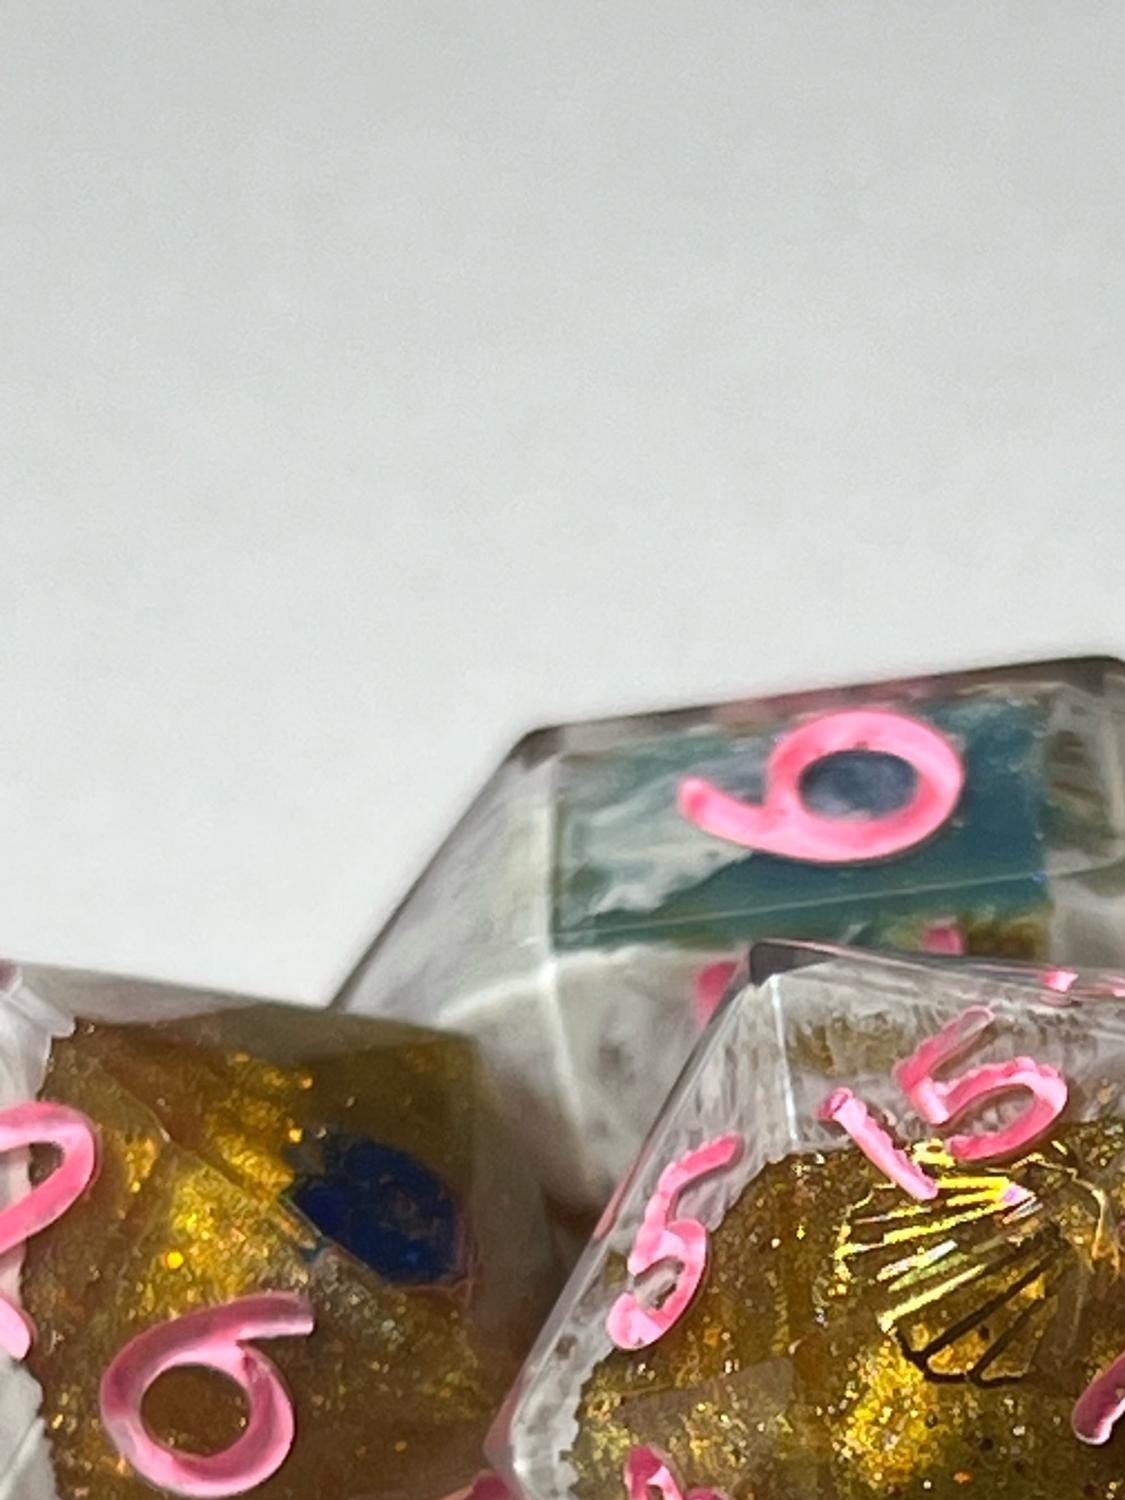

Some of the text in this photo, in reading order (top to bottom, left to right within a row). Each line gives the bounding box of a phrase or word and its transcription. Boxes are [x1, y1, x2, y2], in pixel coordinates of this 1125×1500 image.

[818, 1004, 1068, 1200] 15
[606, 1131, 744, 1350] 5
[102, 1290, 313, 1498] 6
